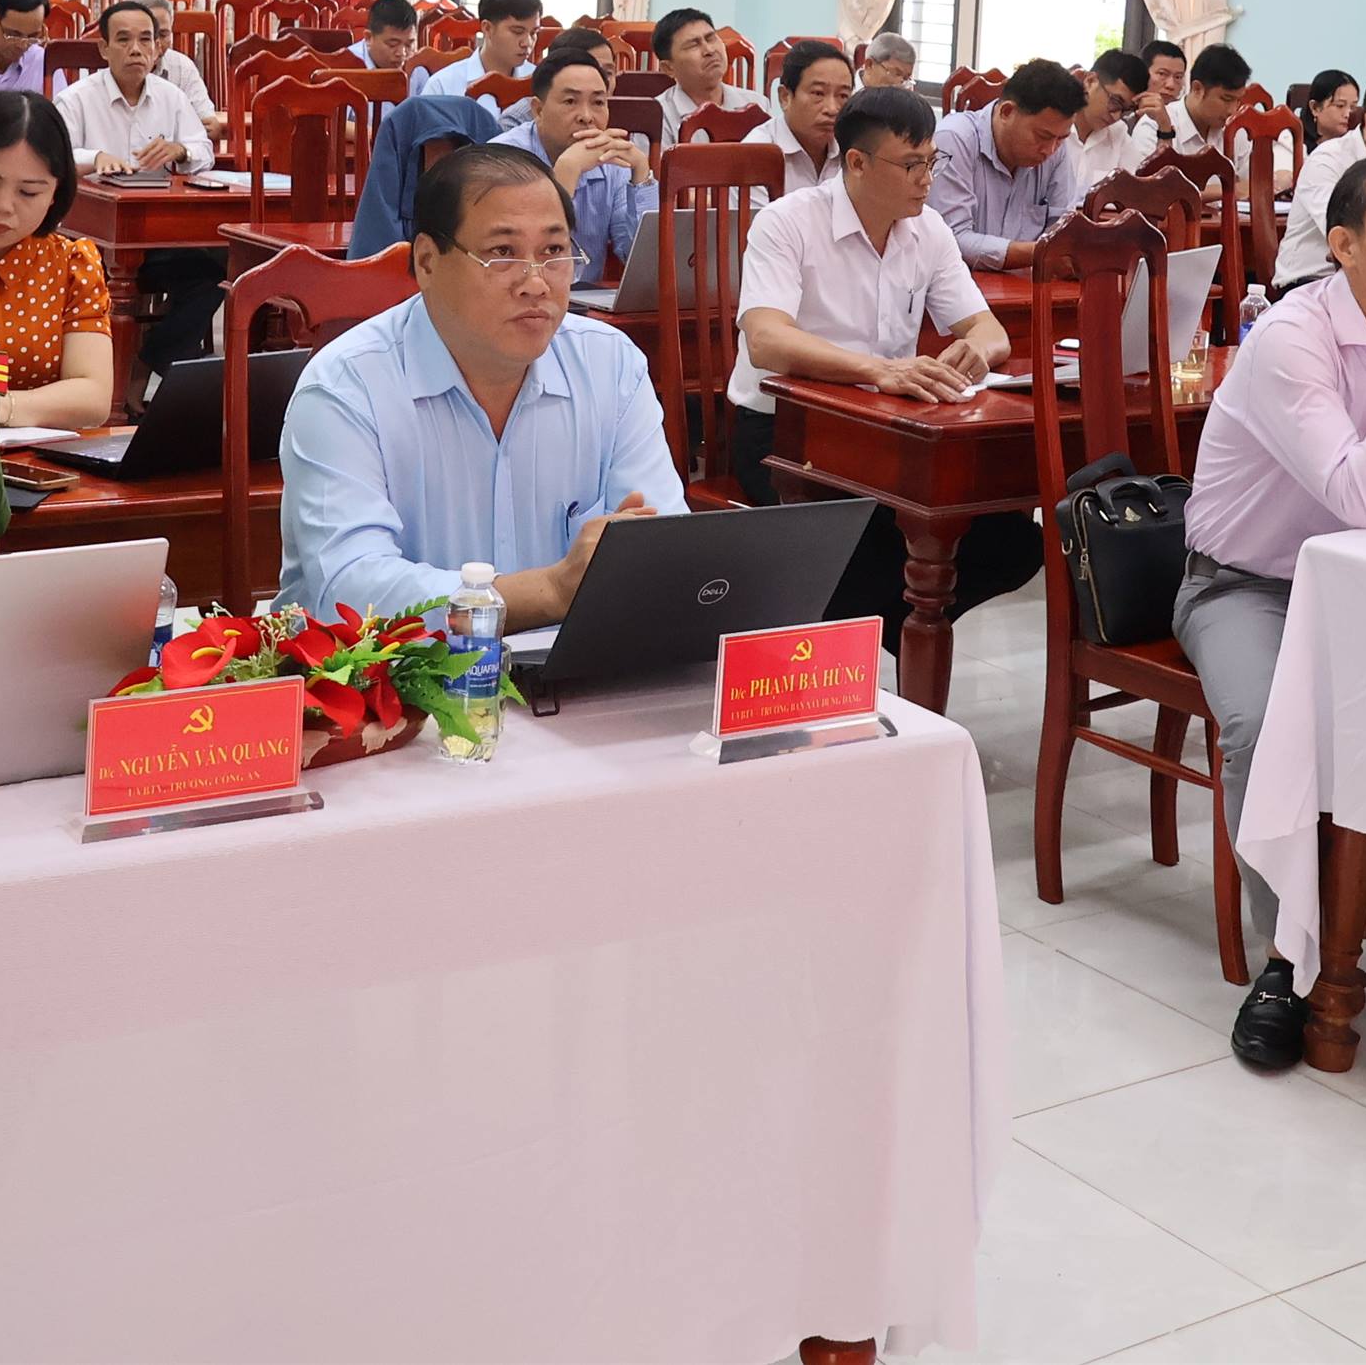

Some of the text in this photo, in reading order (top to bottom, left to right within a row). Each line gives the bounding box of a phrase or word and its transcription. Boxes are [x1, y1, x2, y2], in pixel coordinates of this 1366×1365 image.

[750, 673, 796, 700] PHẠM
[799, 666, 818, 691] BÁ
[823, 662, 866, 687] HÙNG
[119, 744, 190, 777] NGUYỄN
[194, 745, 228, 768] VĂN
[232, 738, 290, 765] QUANG
